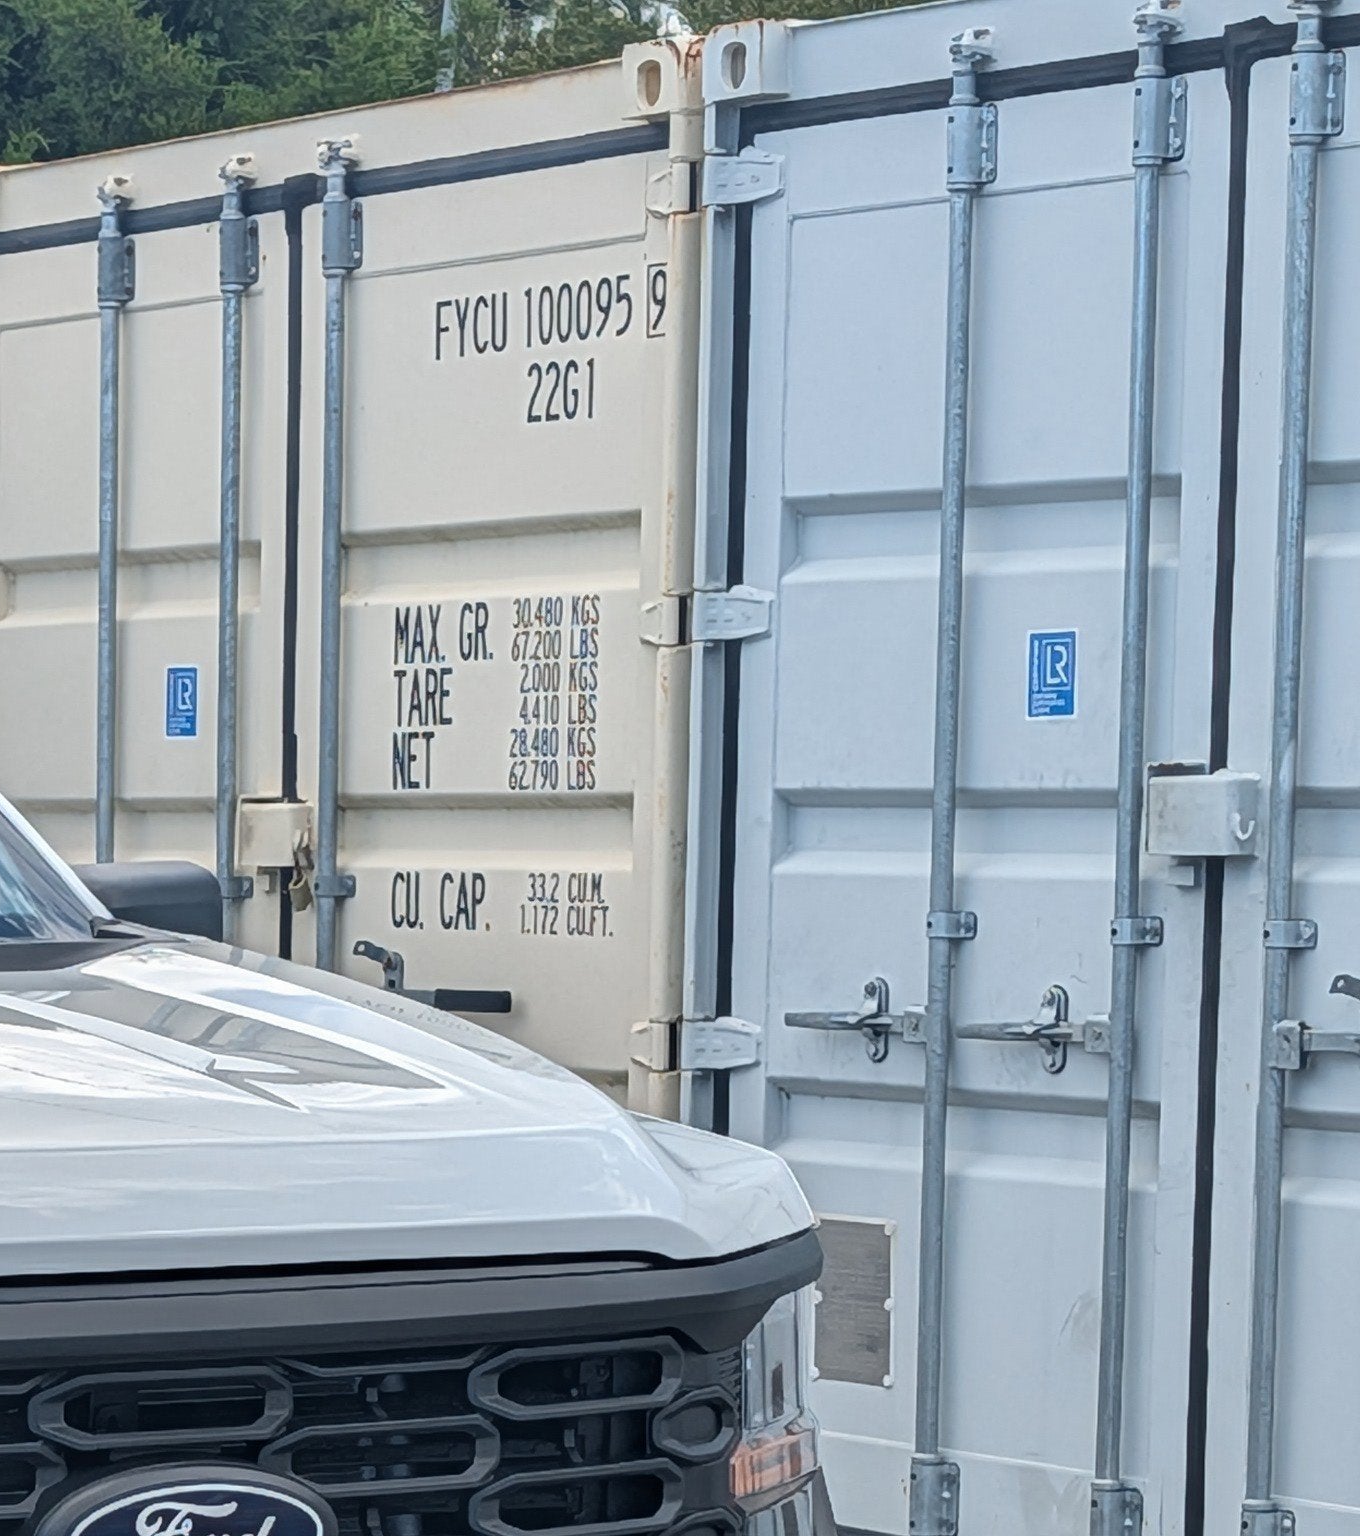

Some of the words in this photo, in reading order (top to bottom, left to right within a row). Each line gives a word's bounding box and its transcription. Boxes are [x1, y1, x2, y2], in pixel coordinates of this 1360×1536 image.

[435, 291, 508, 361] FYCU
[524, 273, 633, 348] 100095
[651, 268, 668, 331] 9
[526, 357, 595, 424] 22G1
[393, 603, 446, 666] MAX.
[458, 601, 494, 662] GR.
[511, 596, 564, 629] 30.480
[570, 593, 601, 627] KGS
[569, 627, 600, 660] LBS
[393, 667, 454, 728] TARE
[568, 660, 599, 693] KGS
[567, 693, 598, 725] LBS
[392, 730, 436, 791] NET
[566, 726, 598, 758] KGS
[566, 759, 597, 791] LBS
[391, 870, 424, 931] CU.
[439, 871, 491, 932] CAP.
[520, 904, 559, 936] 1.172
